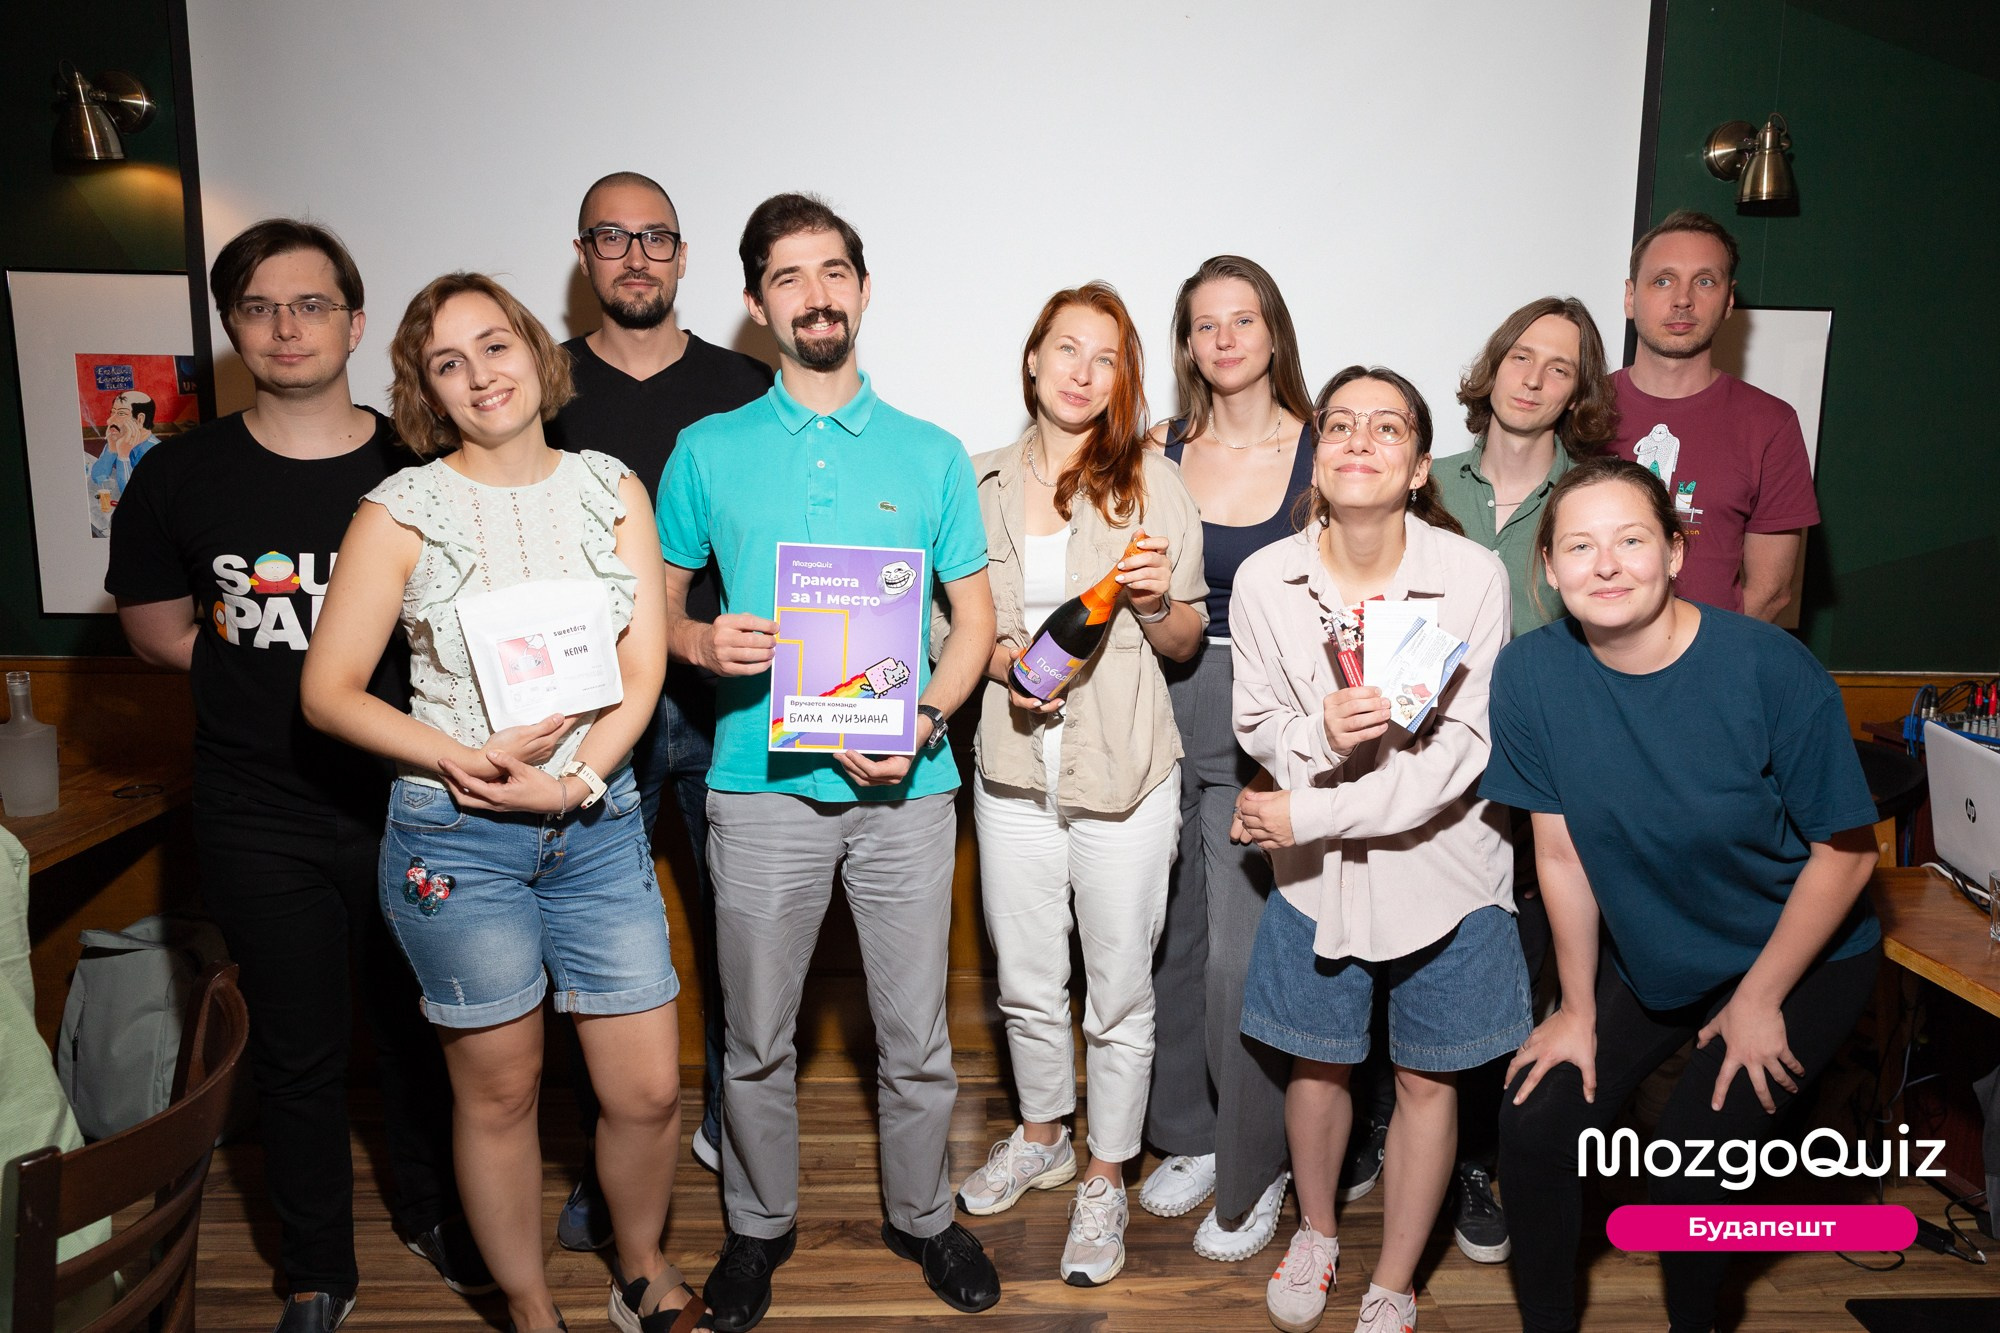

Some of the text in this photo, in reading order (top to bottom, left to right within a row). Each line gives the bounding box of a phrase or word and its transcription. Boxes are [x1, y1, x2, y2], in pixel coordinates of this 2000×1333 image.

[792, 560, 833, 569] MozgoQuiz
[791, 573, 859, 588] Грамота
[790, 591, 881, 607] за 1 место
[564, 644, 588, 657] KENYA
[789, 713, 889, 724] БЛАХА ЛУИЗИАНА
